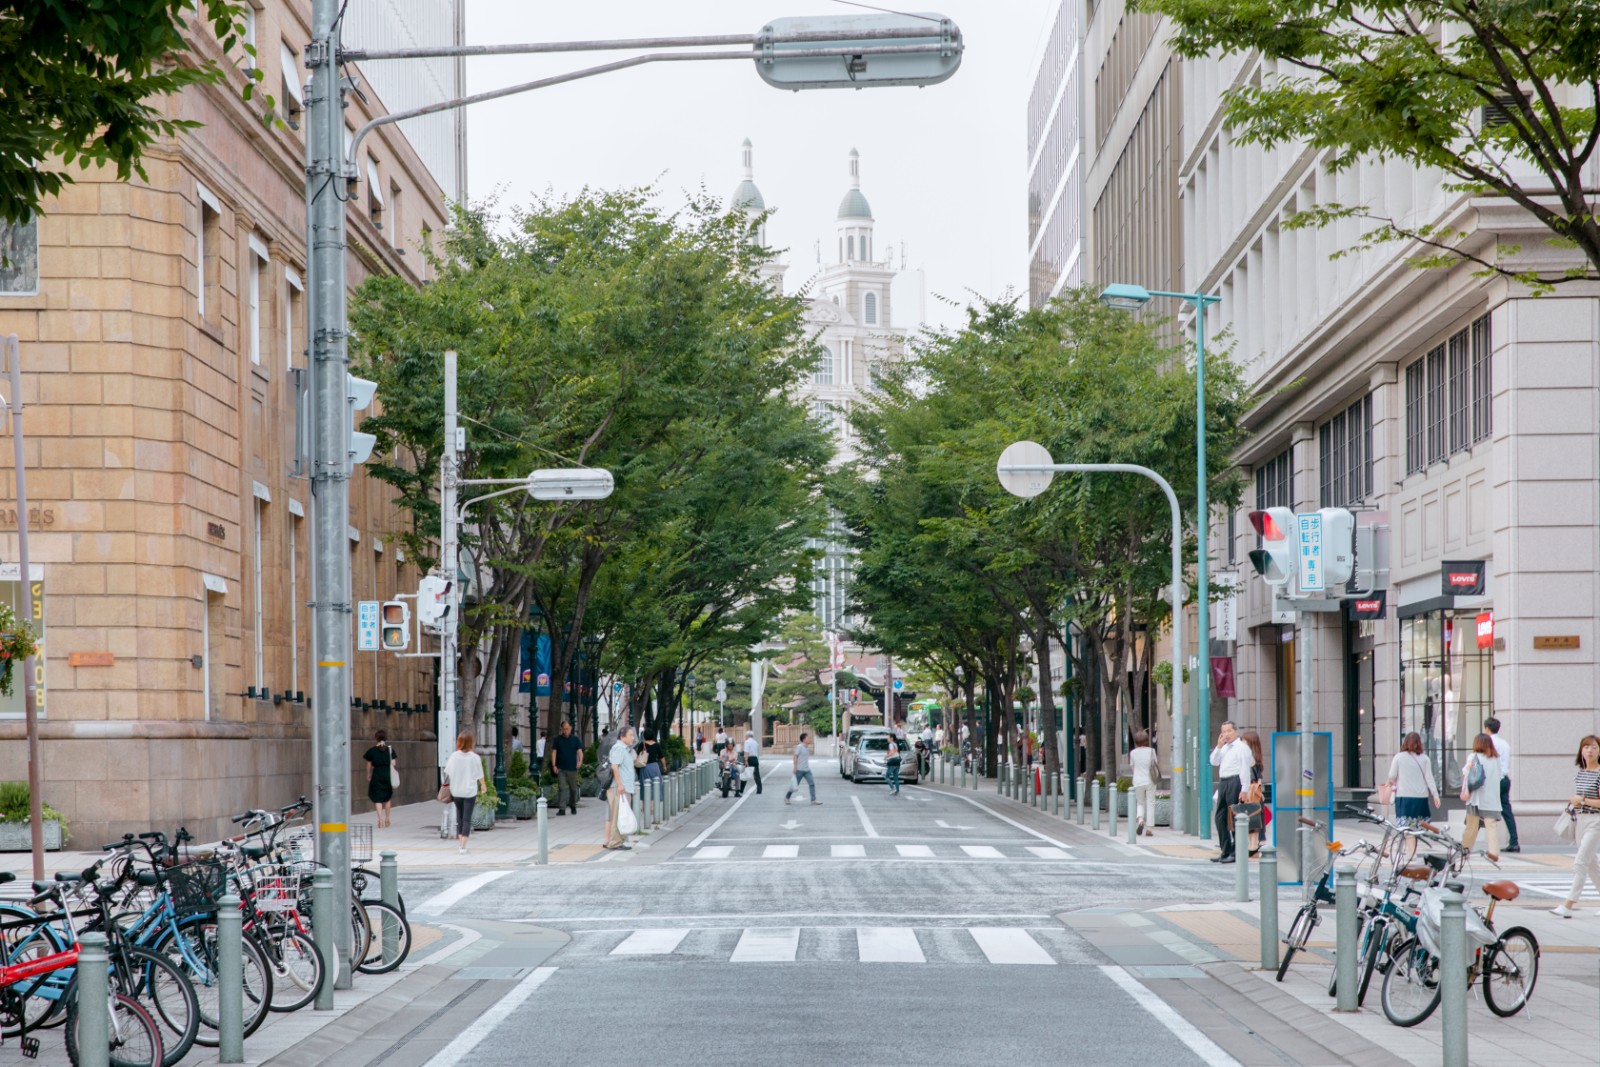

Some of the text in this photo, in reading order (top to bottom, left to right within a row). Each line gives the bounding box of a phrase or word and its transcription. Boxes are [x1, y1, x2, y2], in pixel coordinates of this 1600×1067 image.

[1302, 519, 1310, 556] 自転車
[1311, 518, 1319, 556] 歩行者
